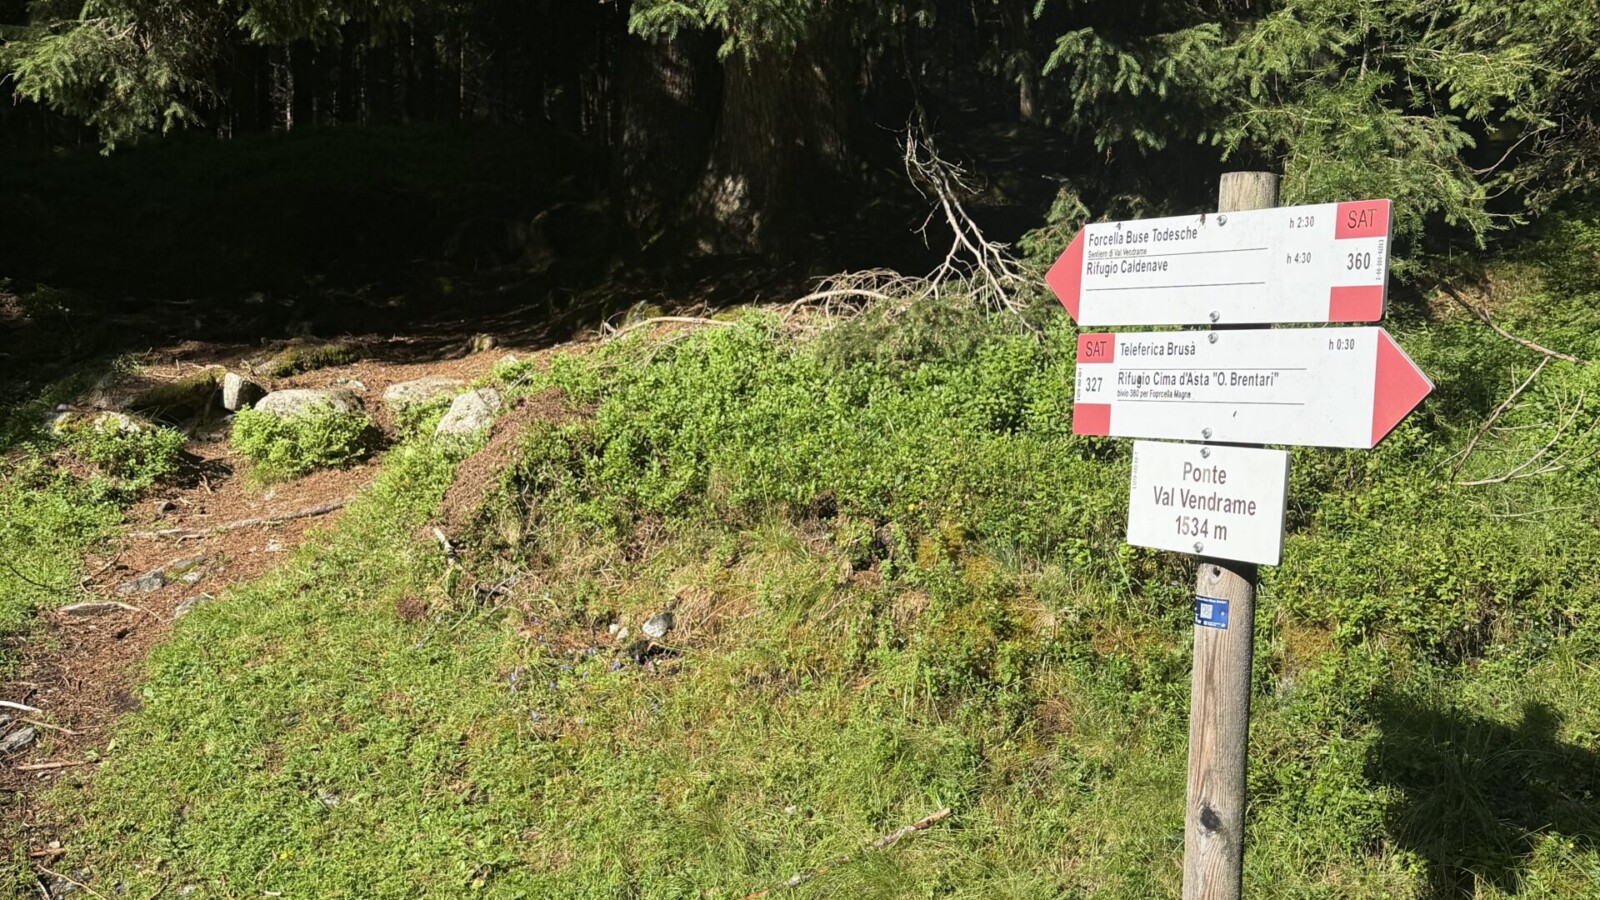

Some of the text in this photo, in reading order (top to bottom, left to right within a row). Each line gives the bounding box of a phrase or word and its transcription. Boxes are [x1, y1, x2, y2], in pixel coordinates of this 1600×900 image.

[1289, 216, 1315, 229] h 2:30
[1347, 209, 1377, 229] SAT
[1088, 226, 1198, 247] Forcella Buse Todesche
[1286, 252, 1312, 264] h 4:30
[1346, 252, 1371, 270] 360
[1086, 259, 1168, 278] Rifugio Caldenave
[1085, 341, 1107, 357] SAT
[1120, 342, 1164, 356] Teleferica
[1328, 338, 1355, 350] h 0:30
[1085, 377, 1103, 392] 327
[1118, 371, 1279, 388] Rifugio Cima d'Asta "O. Brentari"
[1183, 461, 1227, 485] Ponte
[1153, 485, 1257, 516] Val Vendrame
[1175, 515, 1228, 541] 1534 m
